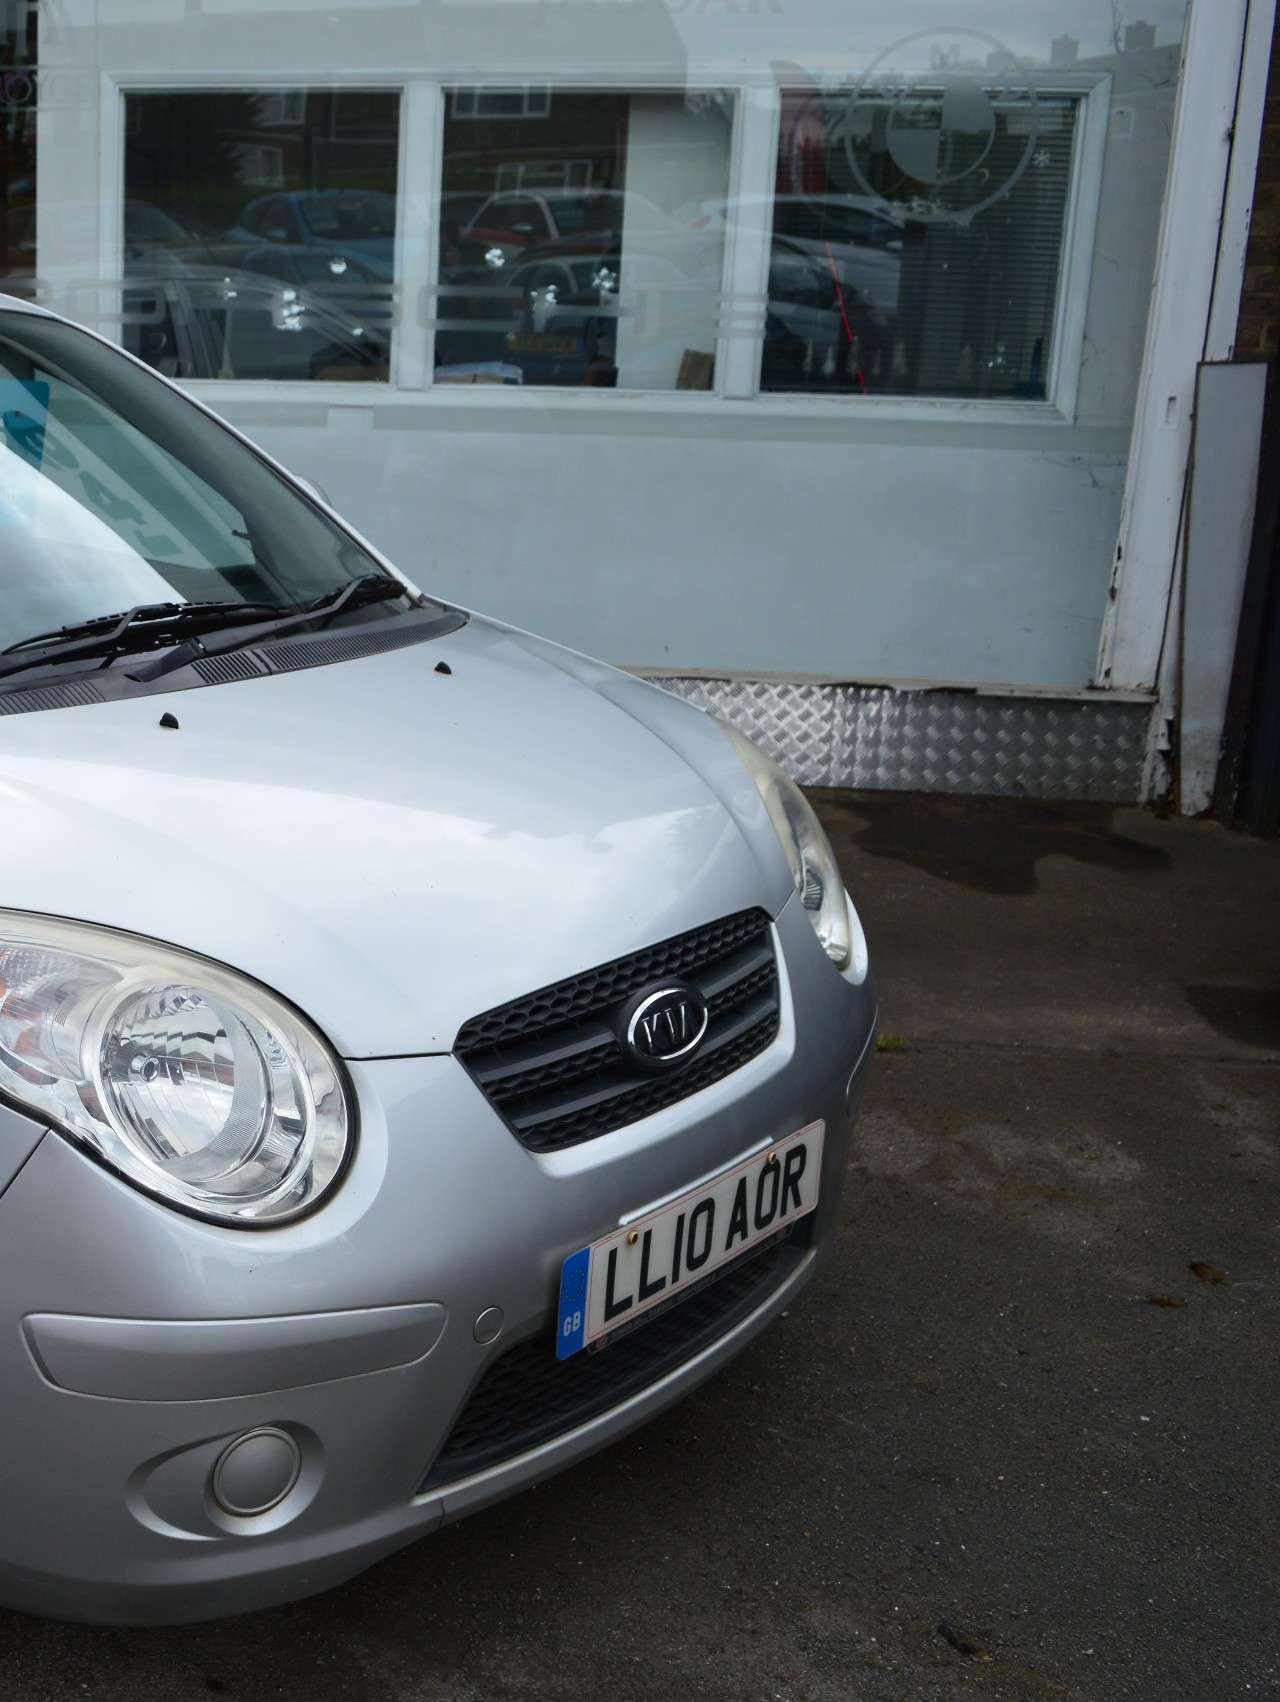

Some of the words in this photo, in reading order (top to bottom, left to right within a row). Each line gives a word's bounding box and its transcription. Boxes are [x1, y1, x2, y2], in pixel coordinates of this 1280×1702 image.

[603, 1196, 716, 1324] LL10
[724, 1142, 809, 1252] AOR
[562, 1313, 582, 1338] GB
